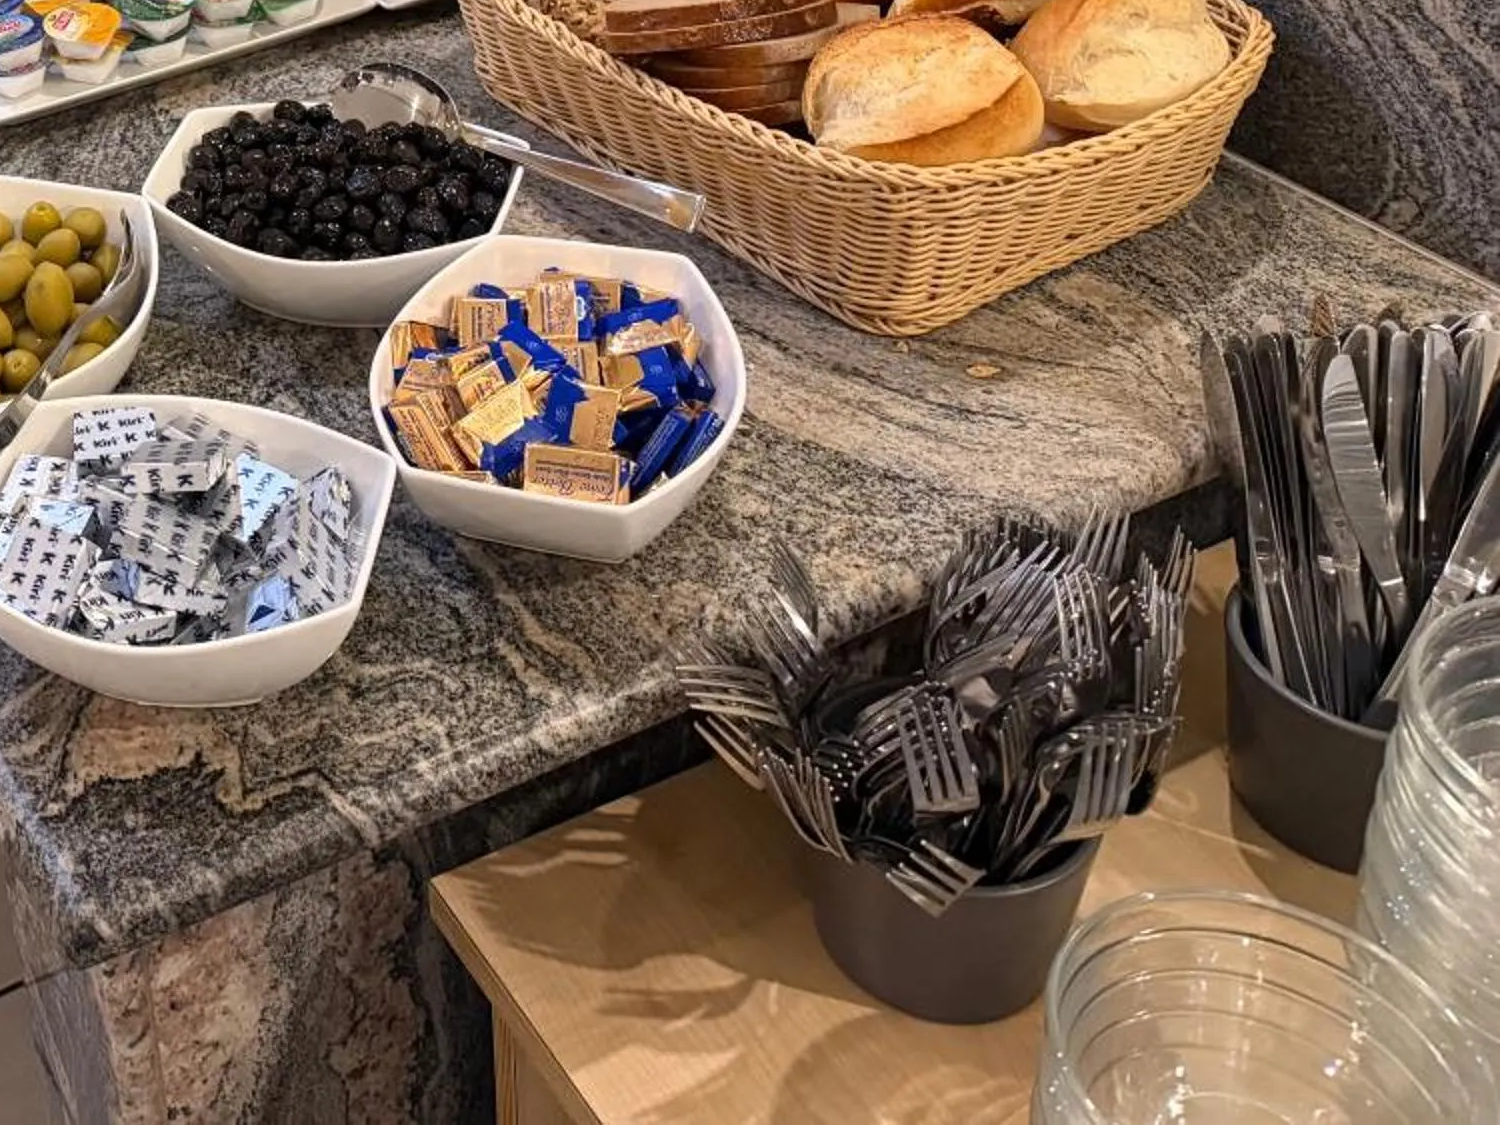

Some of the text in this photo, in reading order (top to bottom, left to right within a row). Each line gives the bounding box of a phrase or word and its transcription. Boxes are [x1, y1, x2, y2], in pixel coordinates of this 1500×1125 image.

[93, 436, 121, 448] Kiri
[58, 553, 77, 581] Kiri
[29, 574, 47, 603] Kiri
